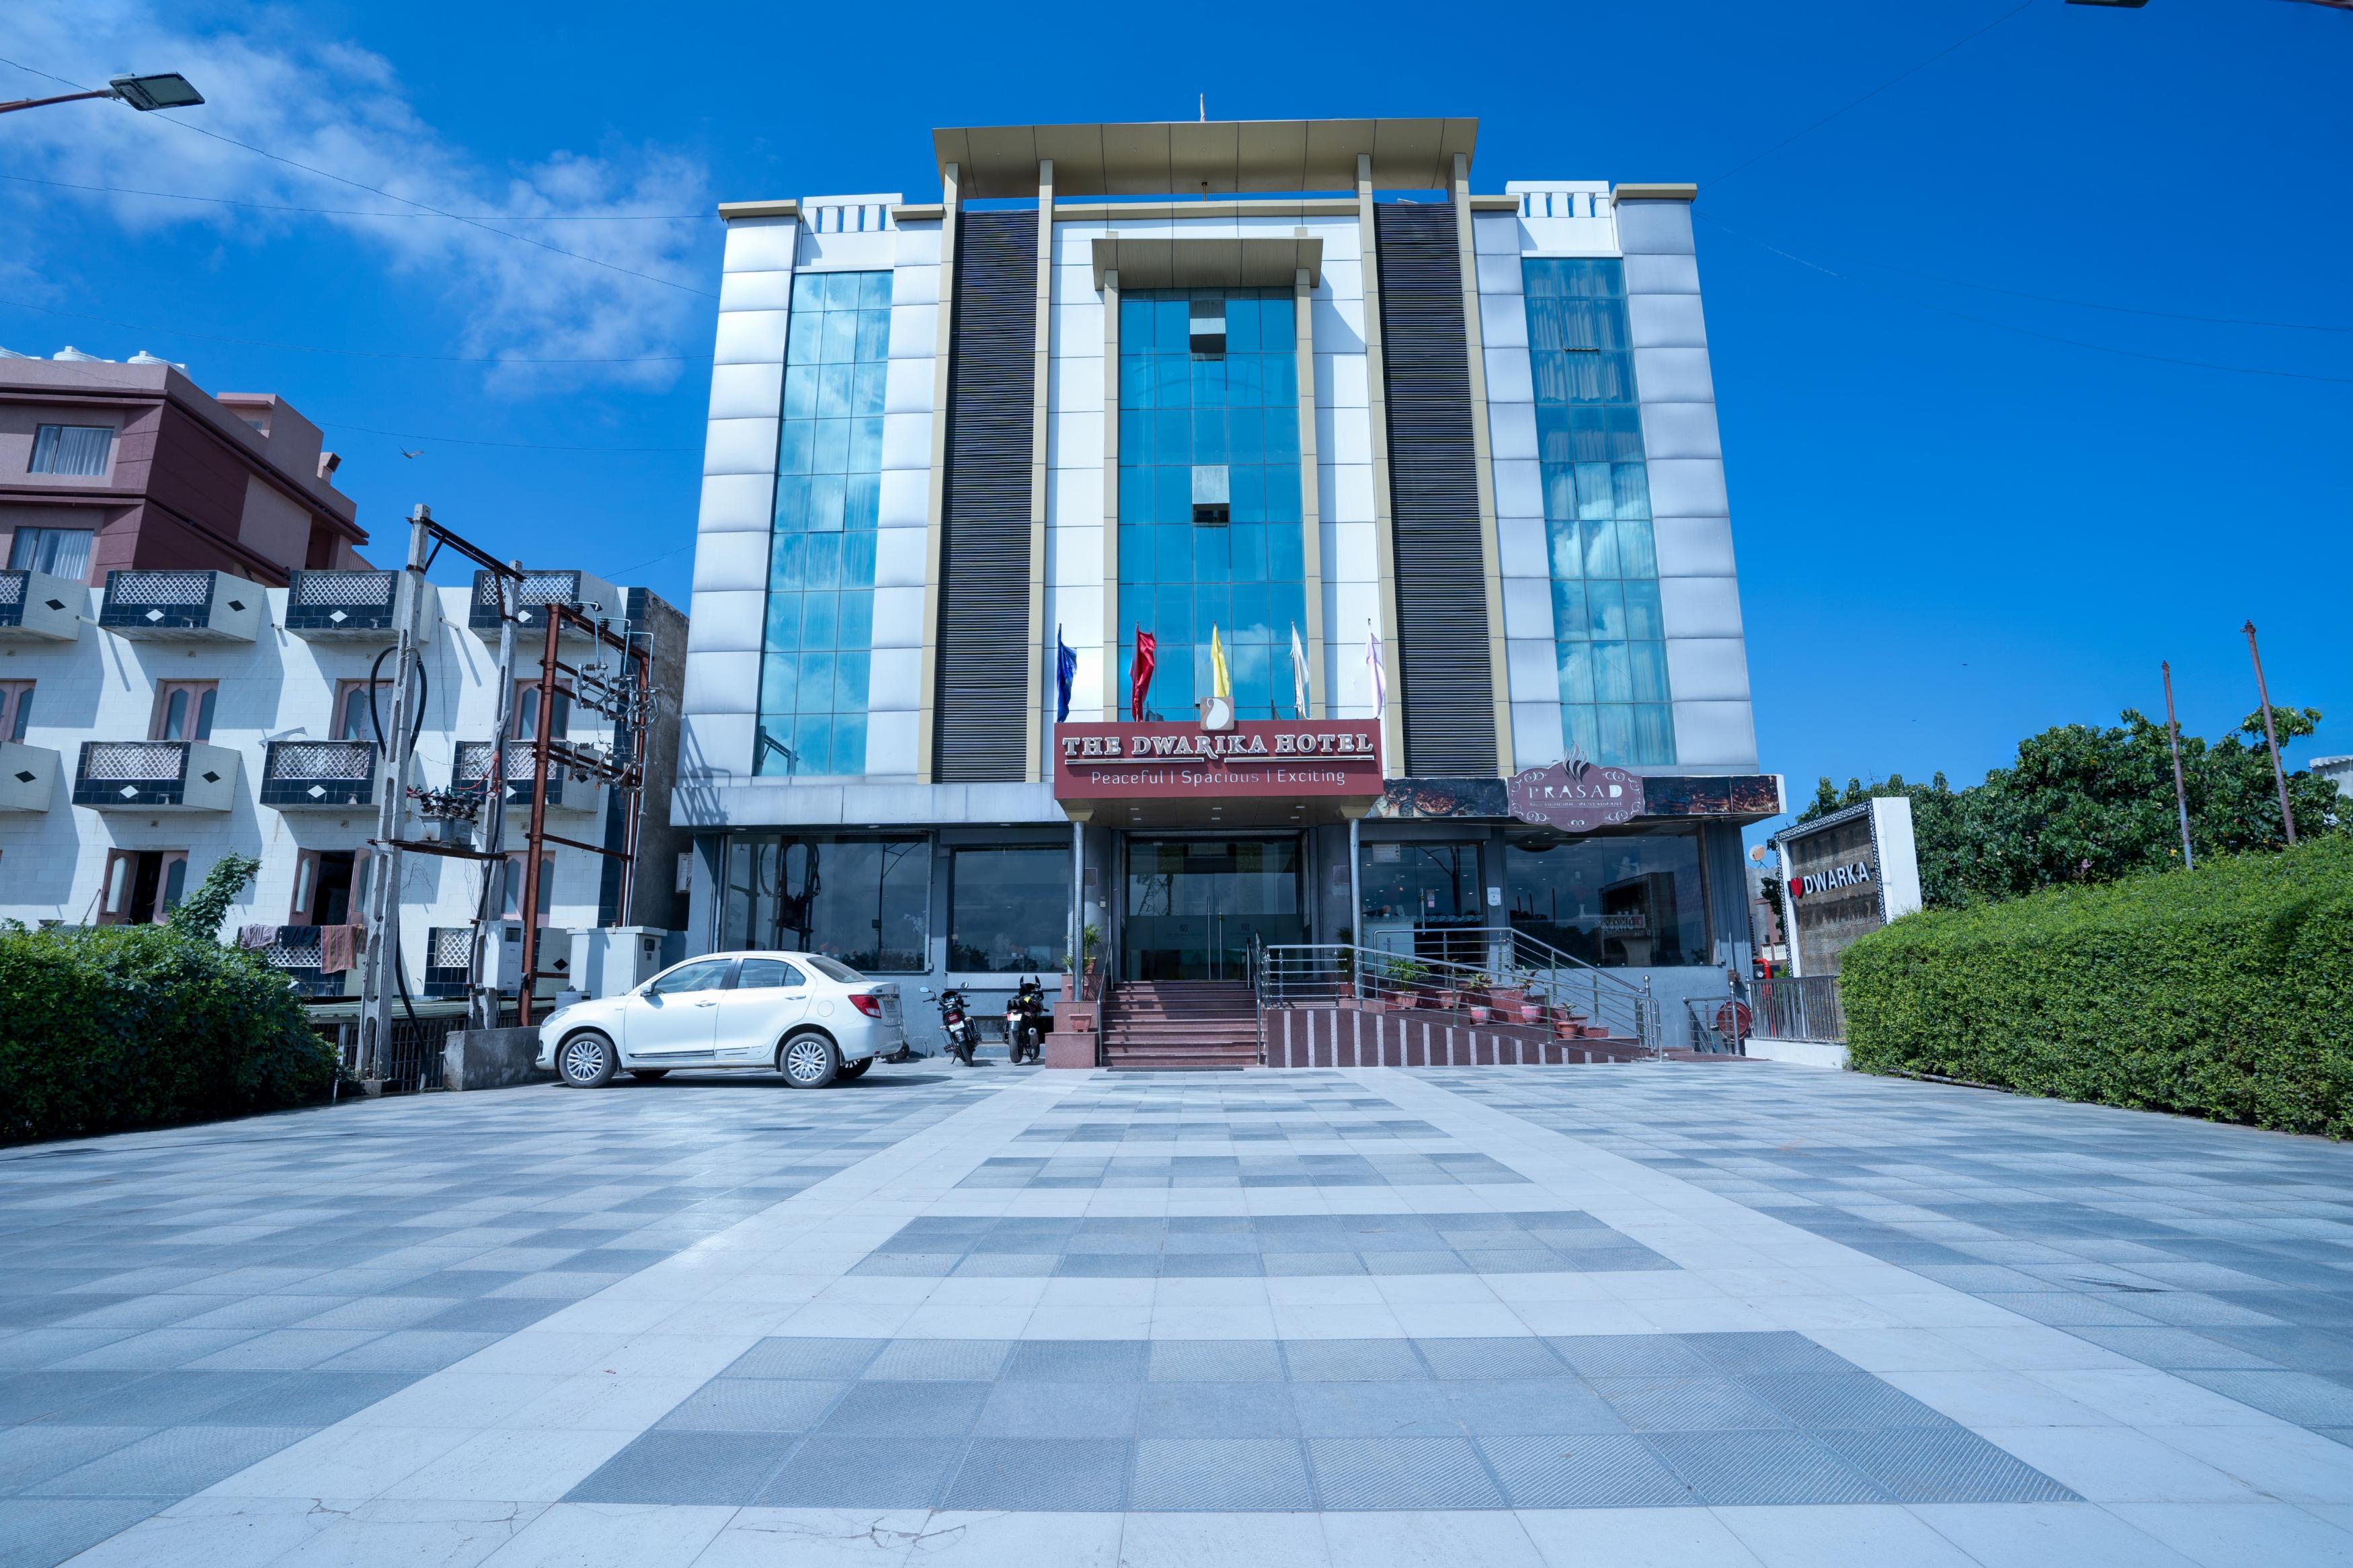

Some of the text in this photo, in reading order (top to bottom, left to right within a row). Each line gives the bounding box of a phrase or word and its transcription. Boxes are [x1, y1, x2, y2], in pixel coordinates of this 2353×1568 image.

[1062, 734, 1373, 759] THE DWARIKA HOTEL
[1091, 770, 1164, 785] Peaceful
[1181, 770, 1260, 786] Spacious
[1277, 768, 1346, 786] Exciting
[1529, 784, 1623, 798] PRASAD
[1803, 860, 1872, 895] DWARKA
